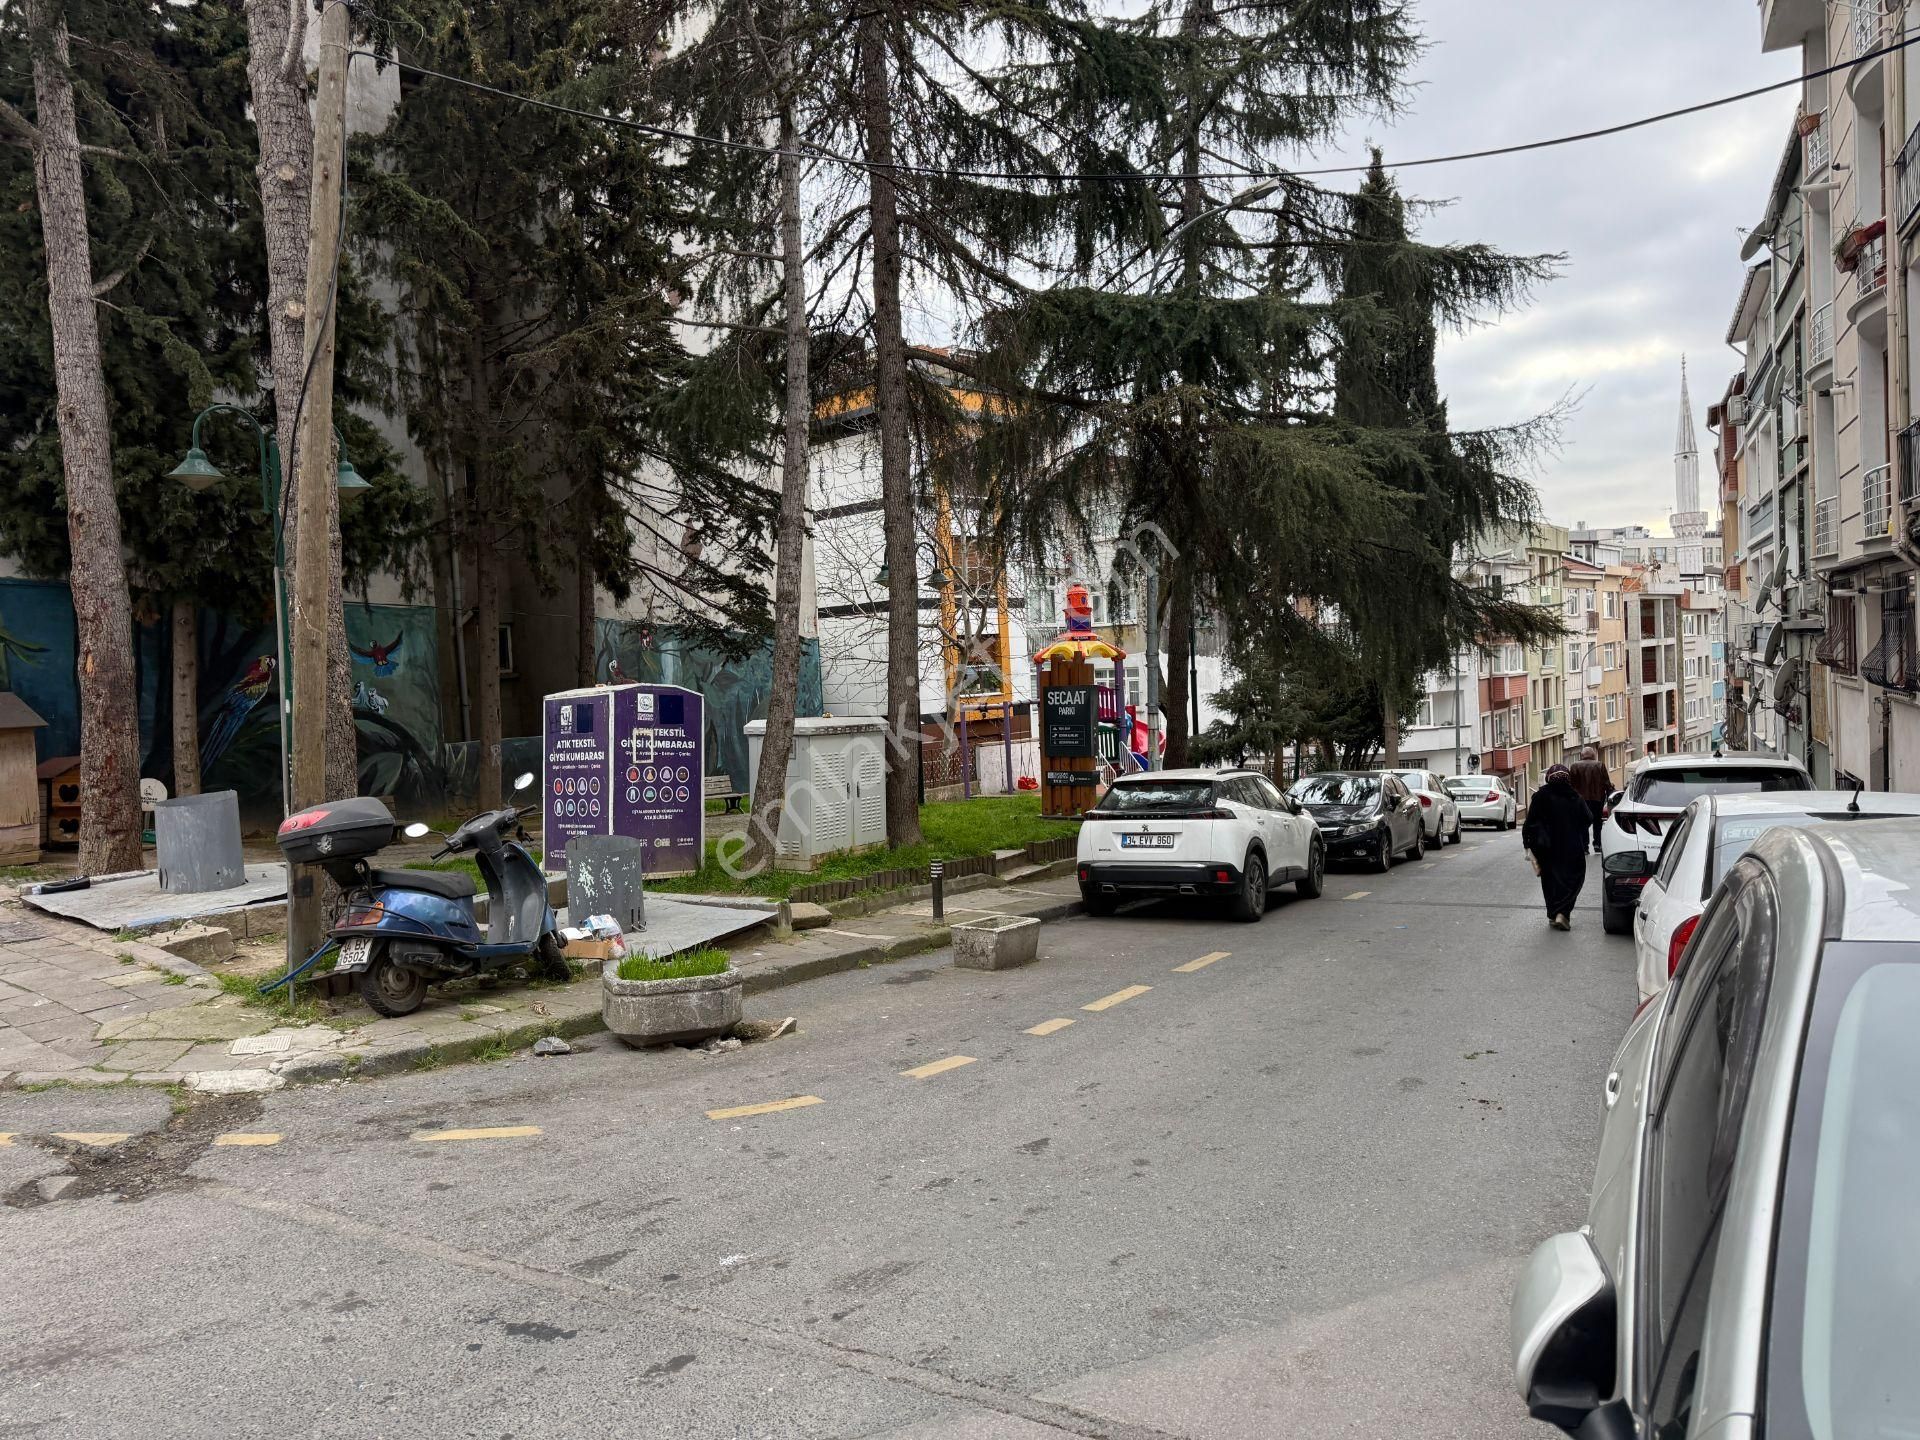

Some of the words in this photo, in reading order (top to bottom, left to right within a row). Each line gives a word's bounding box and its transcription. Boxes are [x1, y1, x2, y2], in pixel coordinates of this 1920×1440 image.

[1047, 690, 1086, 705] SECAAT
[654, 726, 686, 737] TEKSTİL
[556, 739, 571, 750] ATIK
[572, 737, 597, 749] TEKSTİL
[645, 739, 696, 749] KUMBARASI
[549, 751, 565, 762] GİYSİ
[566, 751, 605, 762] KUMBARASI
[1127, 836, 1136, 845] 34
[355, 938, 370, 950] BY
[343, 951, 365, 963] 6502
